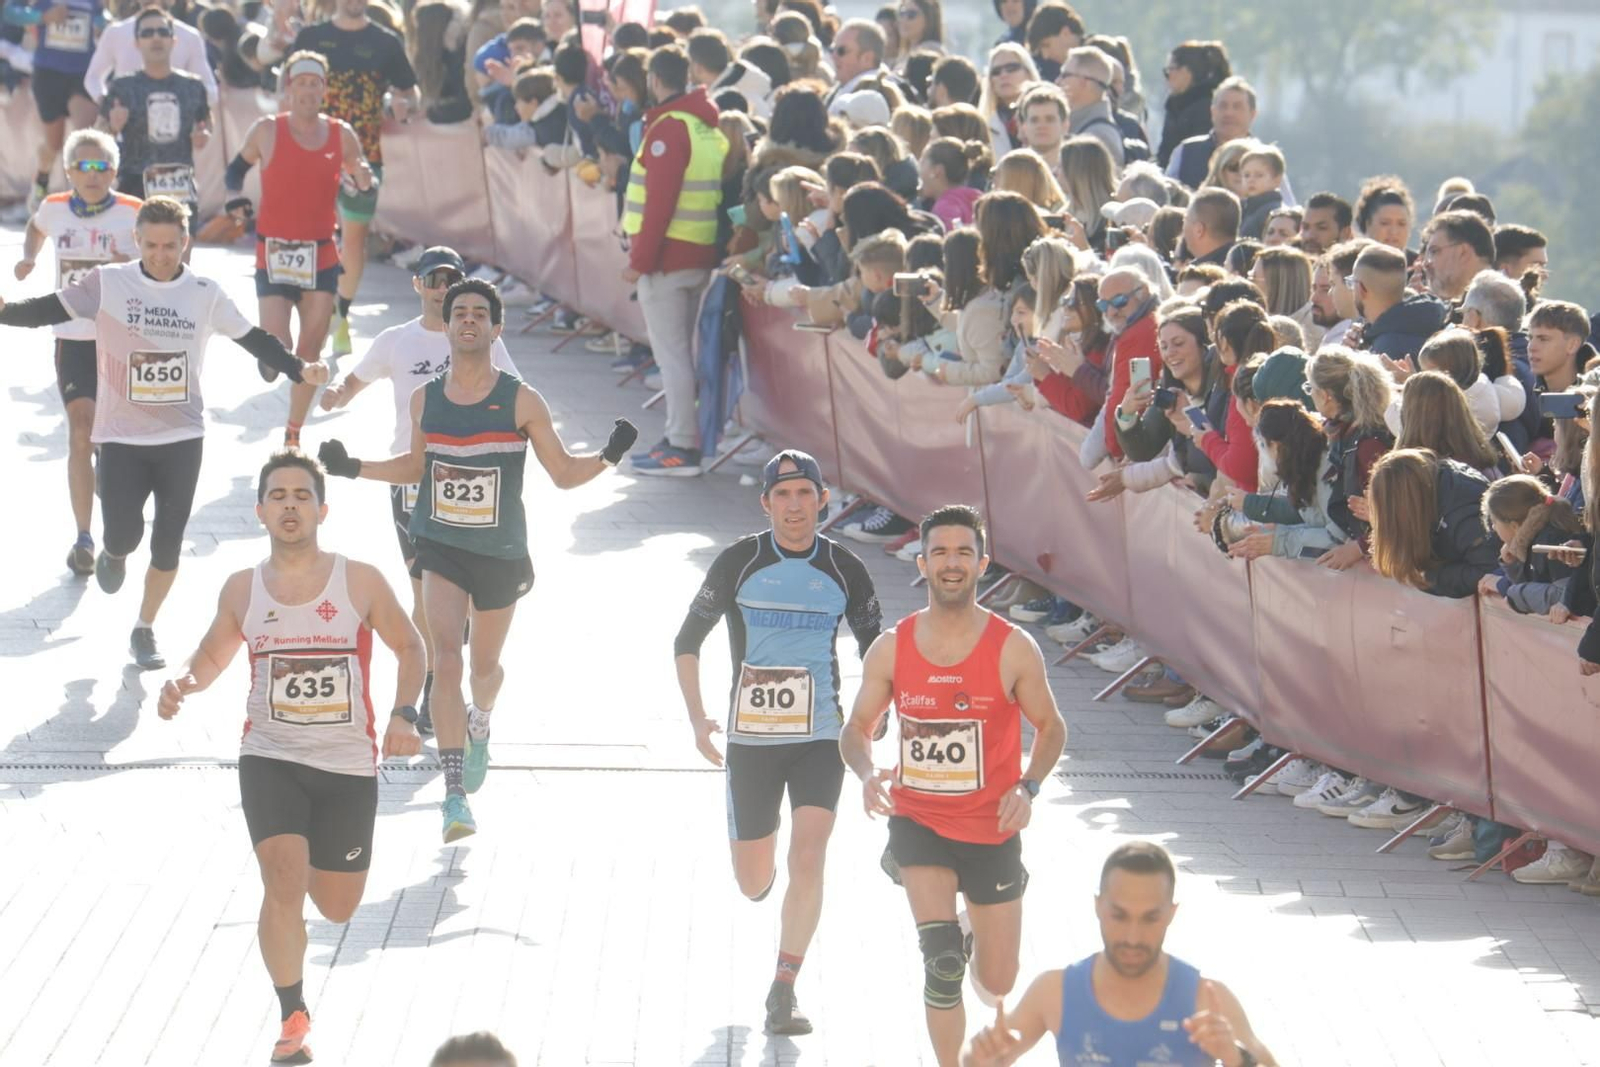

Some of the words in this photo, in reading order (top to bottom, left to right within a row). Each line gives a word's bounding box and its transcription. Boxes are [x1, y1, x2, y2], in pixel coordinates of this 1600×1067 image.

[127, 313, 141, 324] 37
[144, 307, 179, 318] MEDIA
[144, 317, 196, 331] MARATÓN
[136, 366, 183, 382] 1650
[443, 481, 485, 502] 823
[749, 610, 792, 628] MEDIA
[273, 636, 312, 645] Running
[313, 635, 349, 644] Mellaria
[285, 676, 335, 699] 635
[750, 687, 795, 709] 810
[906, 695, 936, 706] califas
[910, 740, 966, 764] 840
